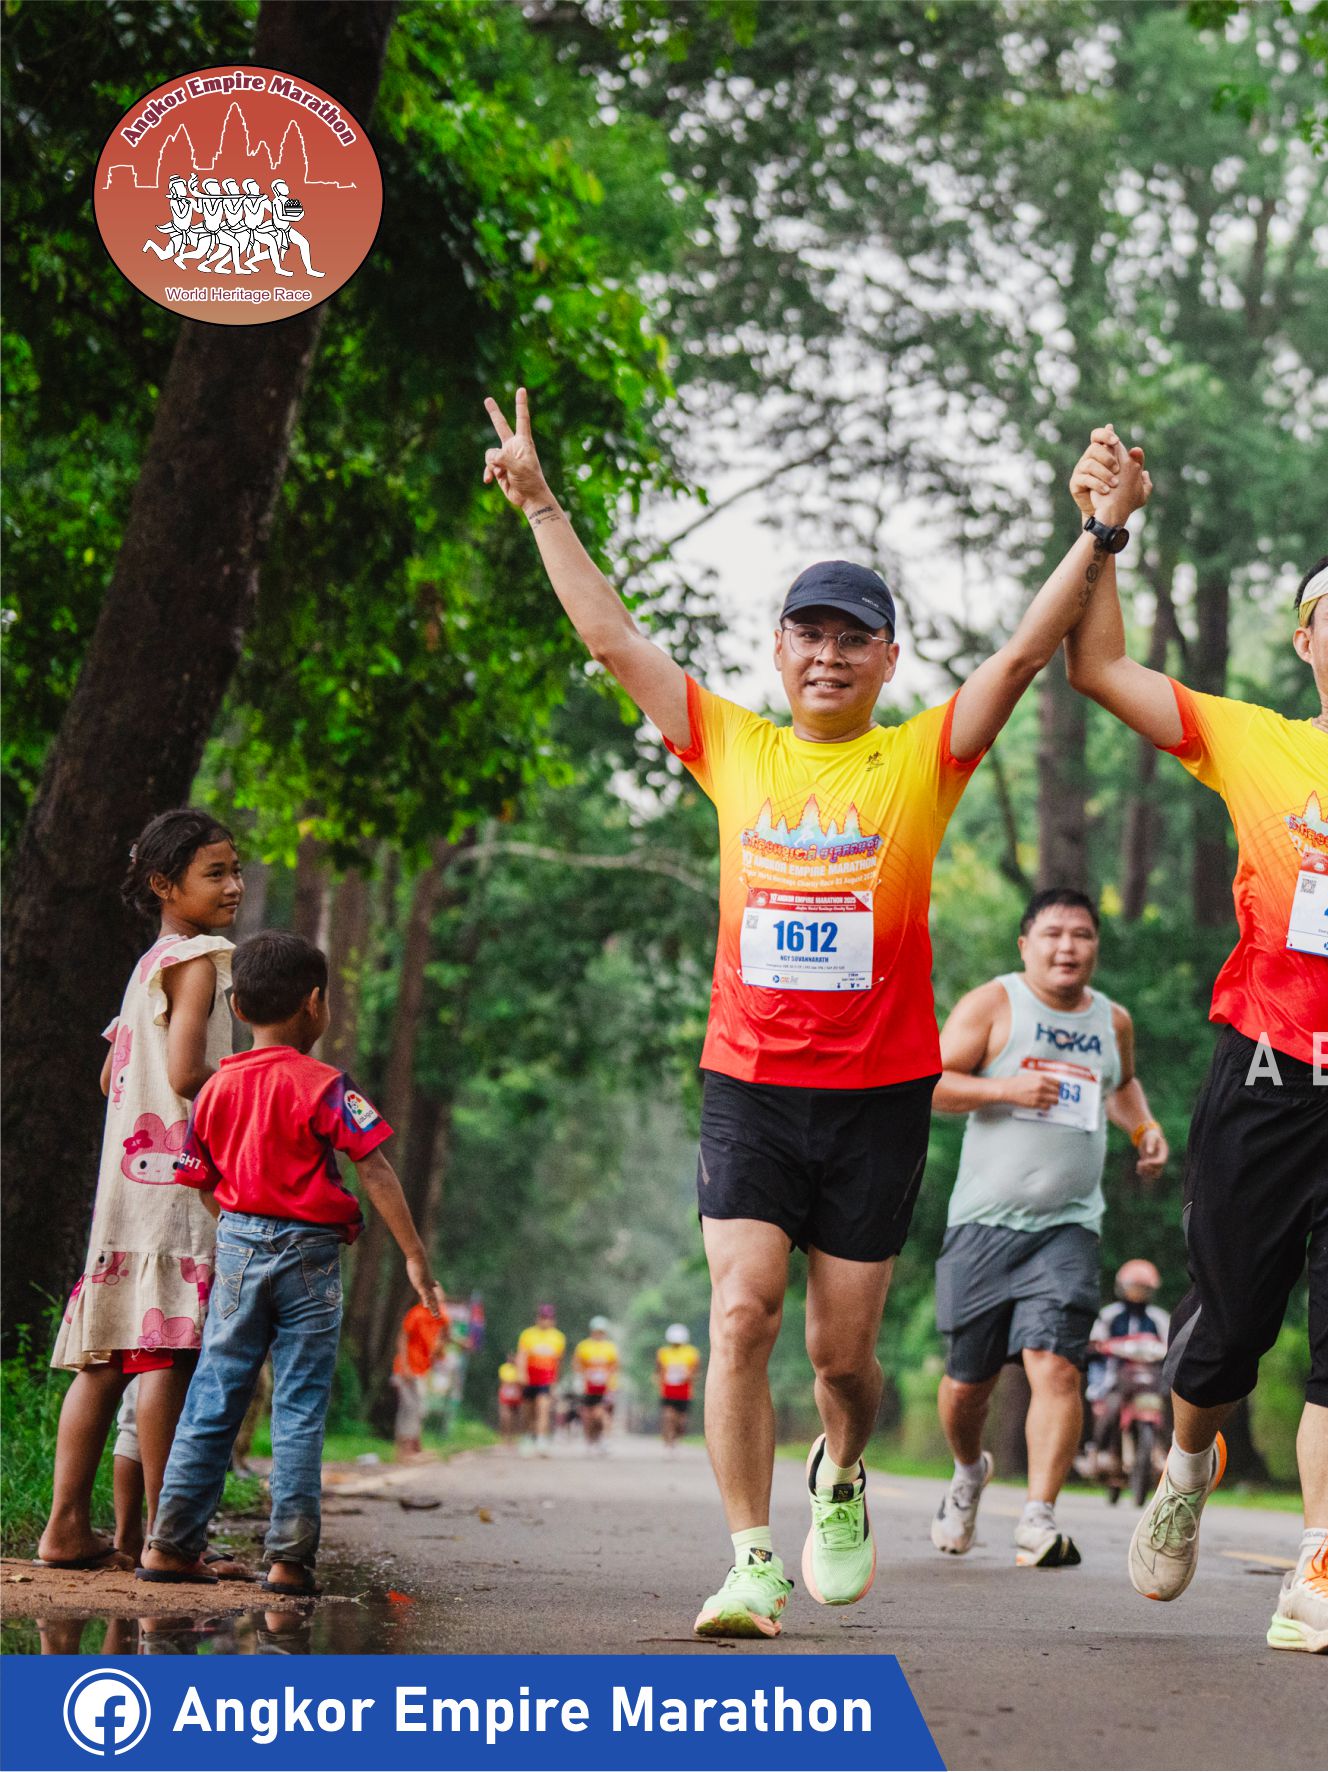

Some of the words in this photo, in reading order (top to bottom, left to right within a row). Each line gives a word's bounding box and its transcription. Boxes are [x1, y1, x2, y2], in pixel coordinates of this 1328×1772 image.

[789, 865, 825, 877] EMPIRE
[828, 856, 877, 875] MARATHON
[773, 920, 838, 953] 1612
[1035, 1022, 1102, 1055] HOKA
[1058, 1081, 1081, 1103] 63
